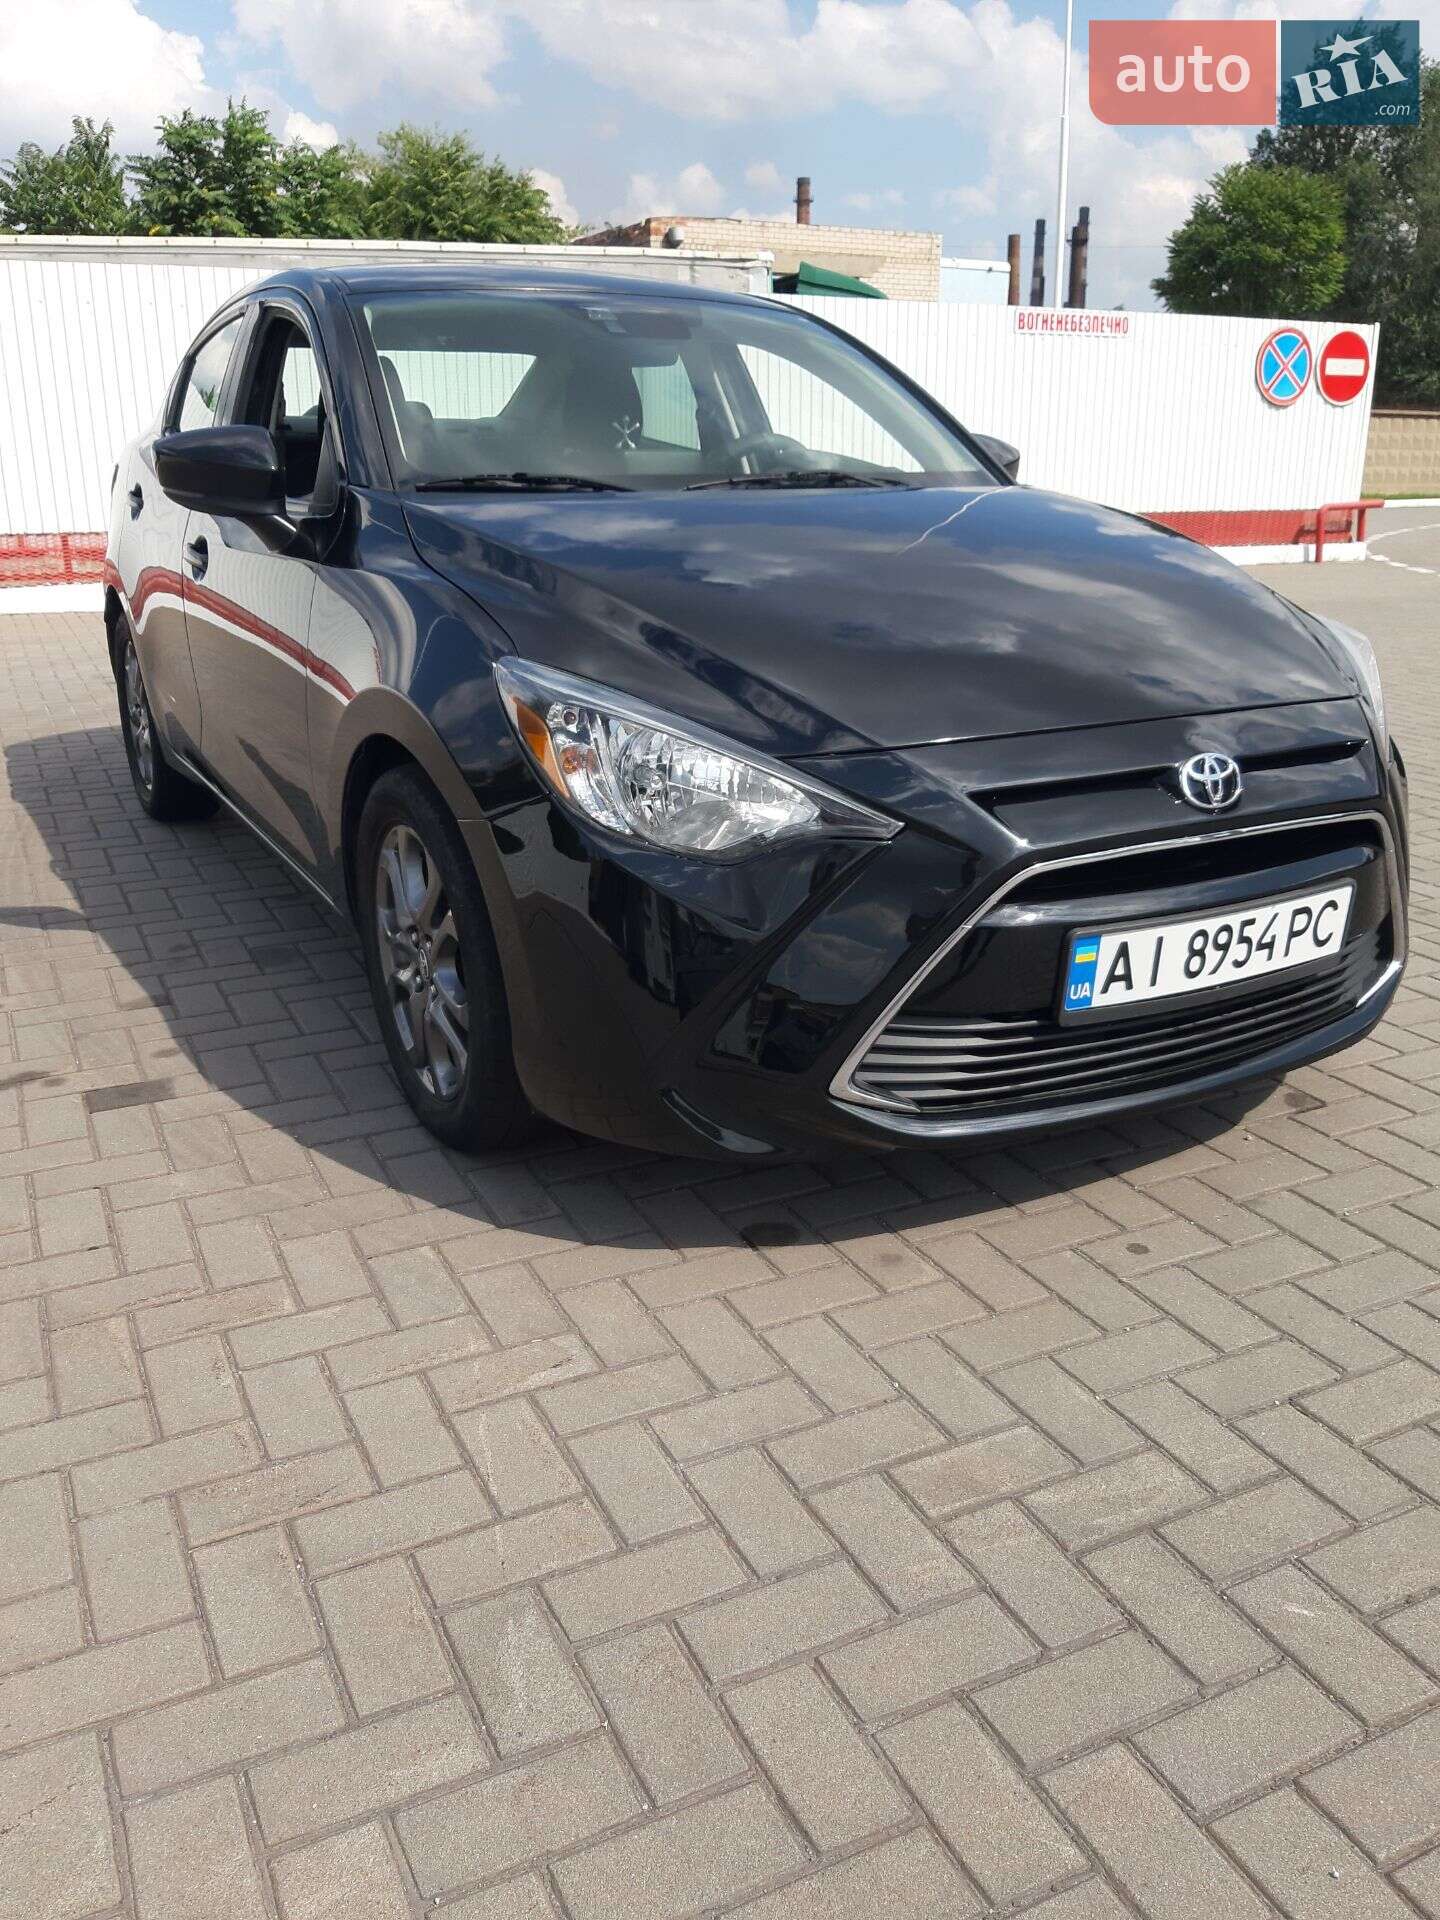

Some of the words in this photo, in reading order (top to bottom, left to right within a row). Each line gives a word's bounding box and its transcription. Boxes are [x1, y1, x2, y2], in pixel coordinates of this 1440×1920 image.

[1018, 312, 1129, 334] ВОГНЕНЕБЕЗПЕЧНО
[1100, 935, 1164, 994] AI
[1184, 911, 1280, 979] 8954
[1069, 984, 1091, 1000] UA
